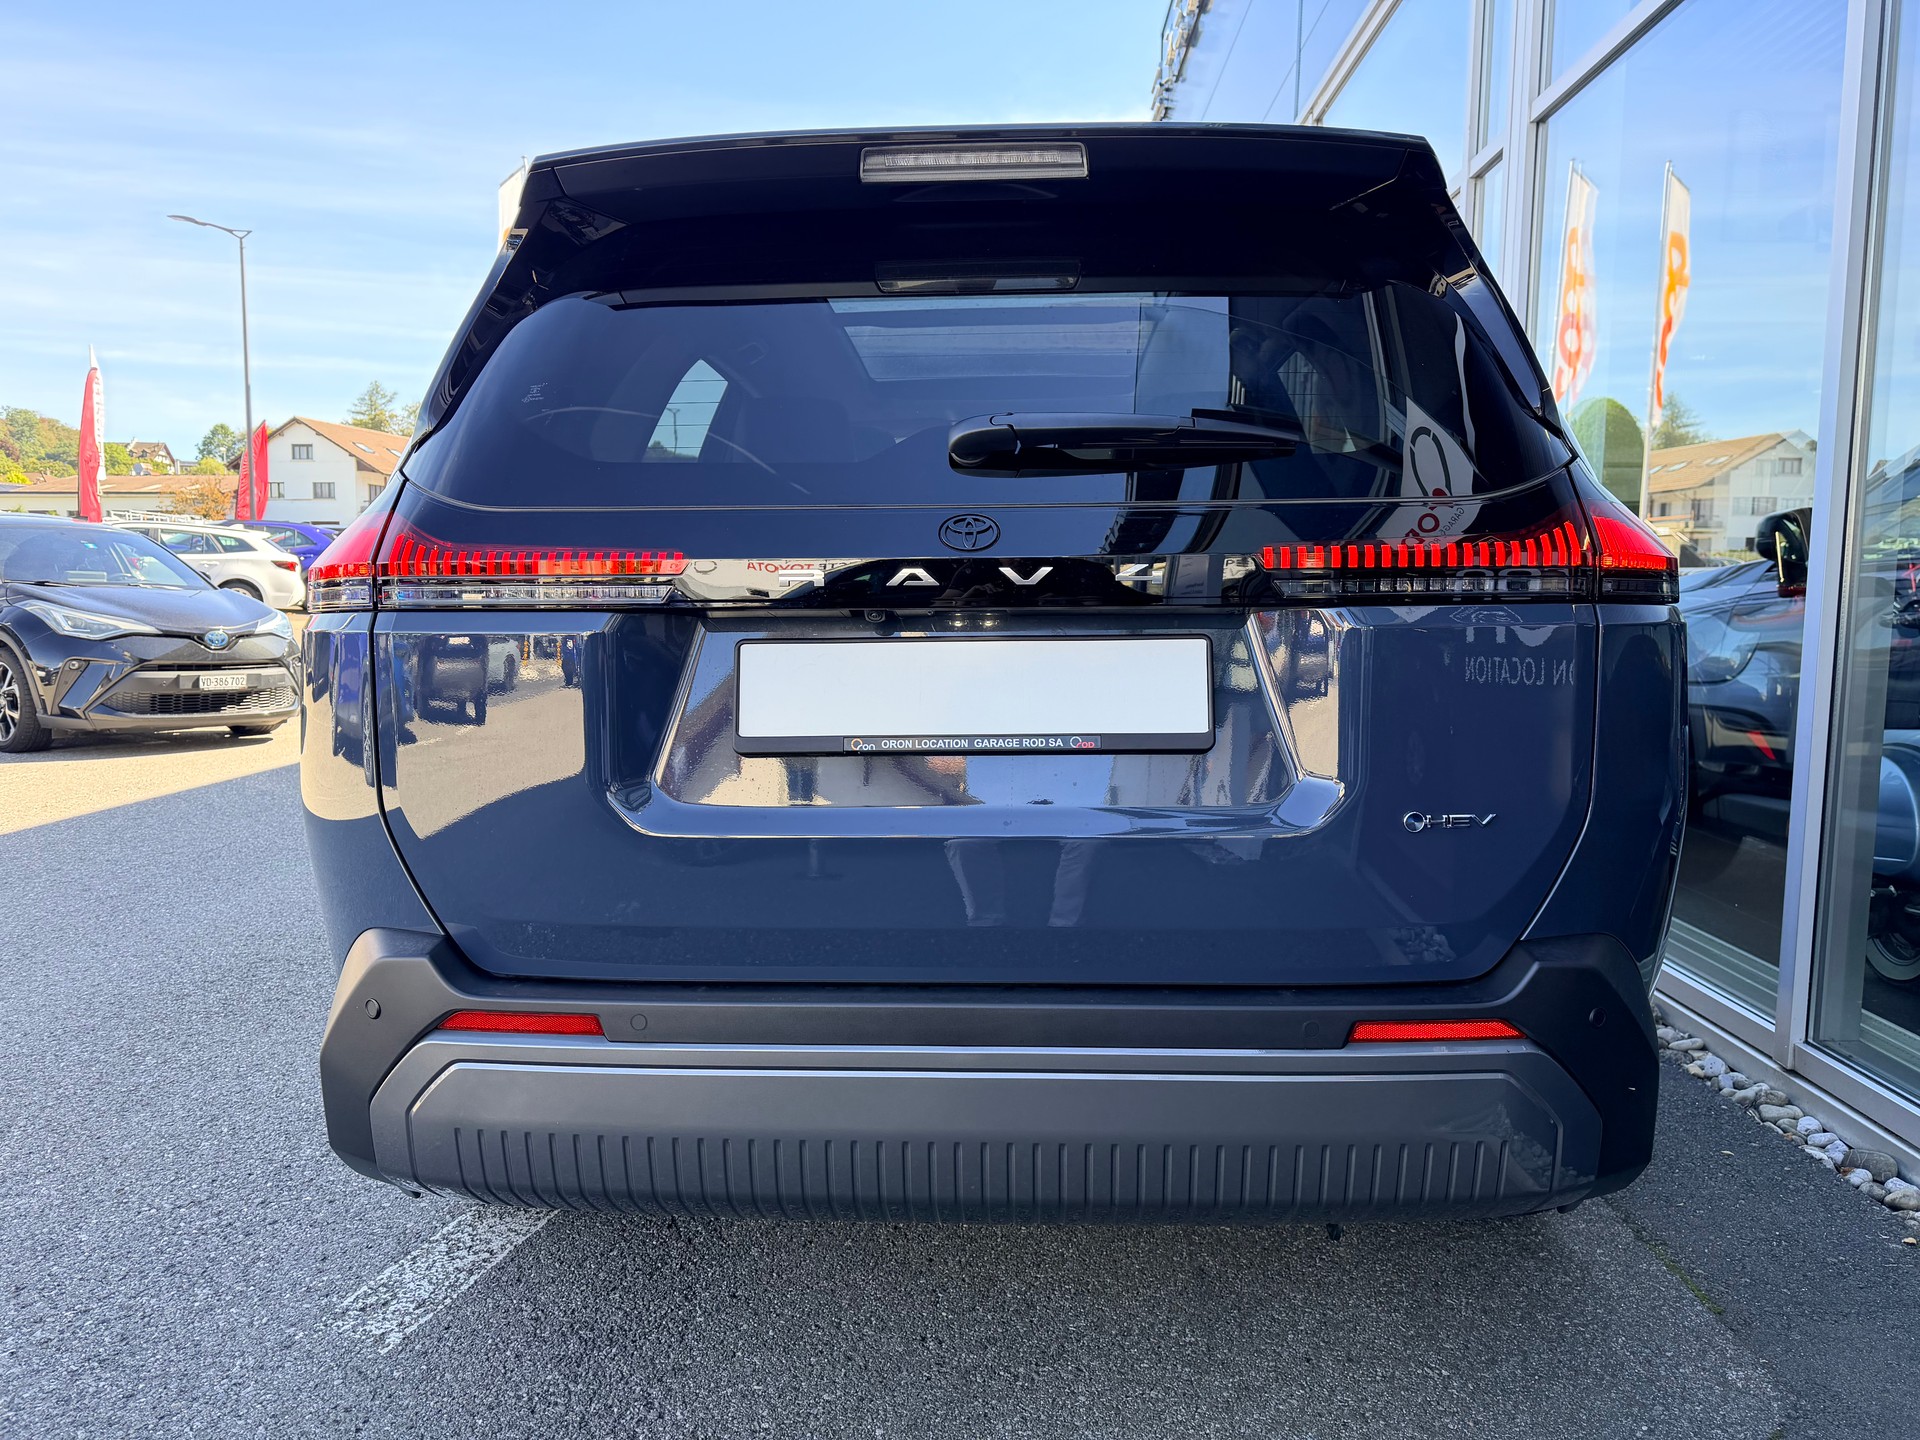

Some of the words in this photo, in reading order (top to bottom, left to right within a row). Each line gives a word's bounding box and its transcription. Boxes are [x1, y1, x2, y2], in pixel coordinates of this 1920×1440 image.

[881, 739, 912, 749] ORON
[915, 739, 968, 749] LOCATION
[974, 738, 1020, 748] GARAGE
[1022, 738, 1046, 748] ROD
[1048, 737, 1063, 748] SA
[1425, 813, 1497, 828] HEV
